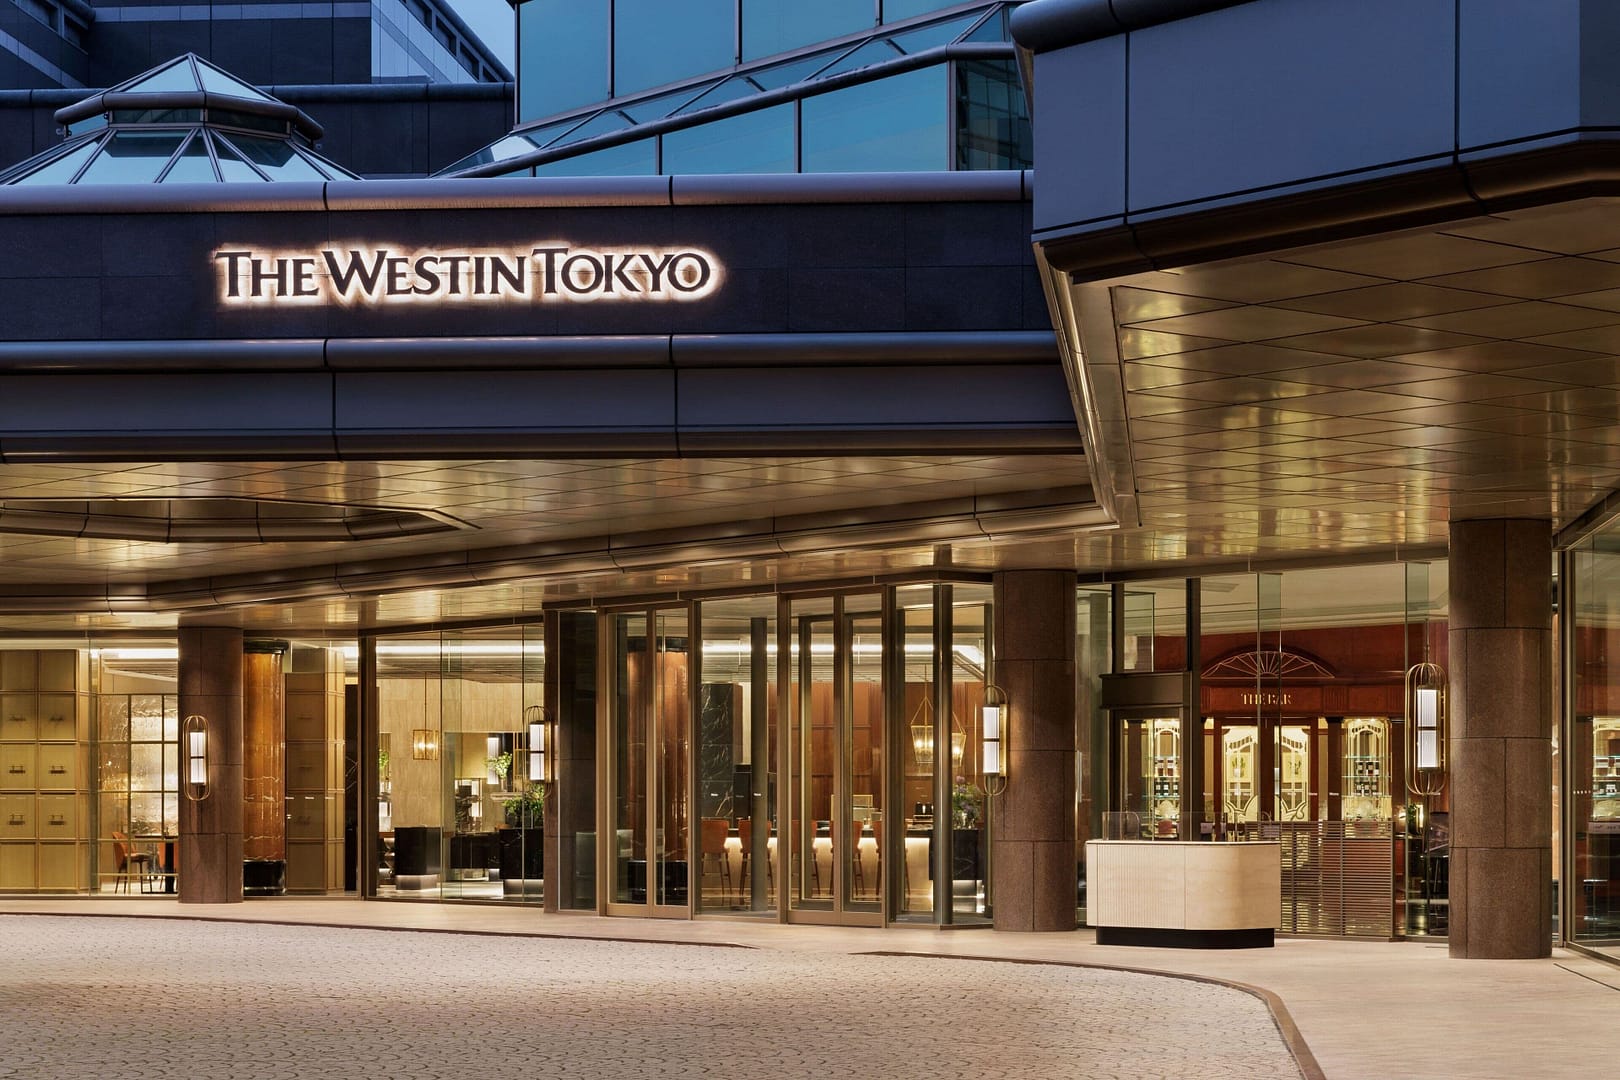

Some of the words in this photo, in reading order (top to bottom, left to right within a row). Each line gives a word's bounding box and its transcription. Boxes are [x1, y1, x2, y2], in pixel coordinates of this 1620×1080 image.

[215, 250, 319, 298] THE
[321, 249, 526, 298] WESTIN
[532, 247, 712, 295] TOKYO
